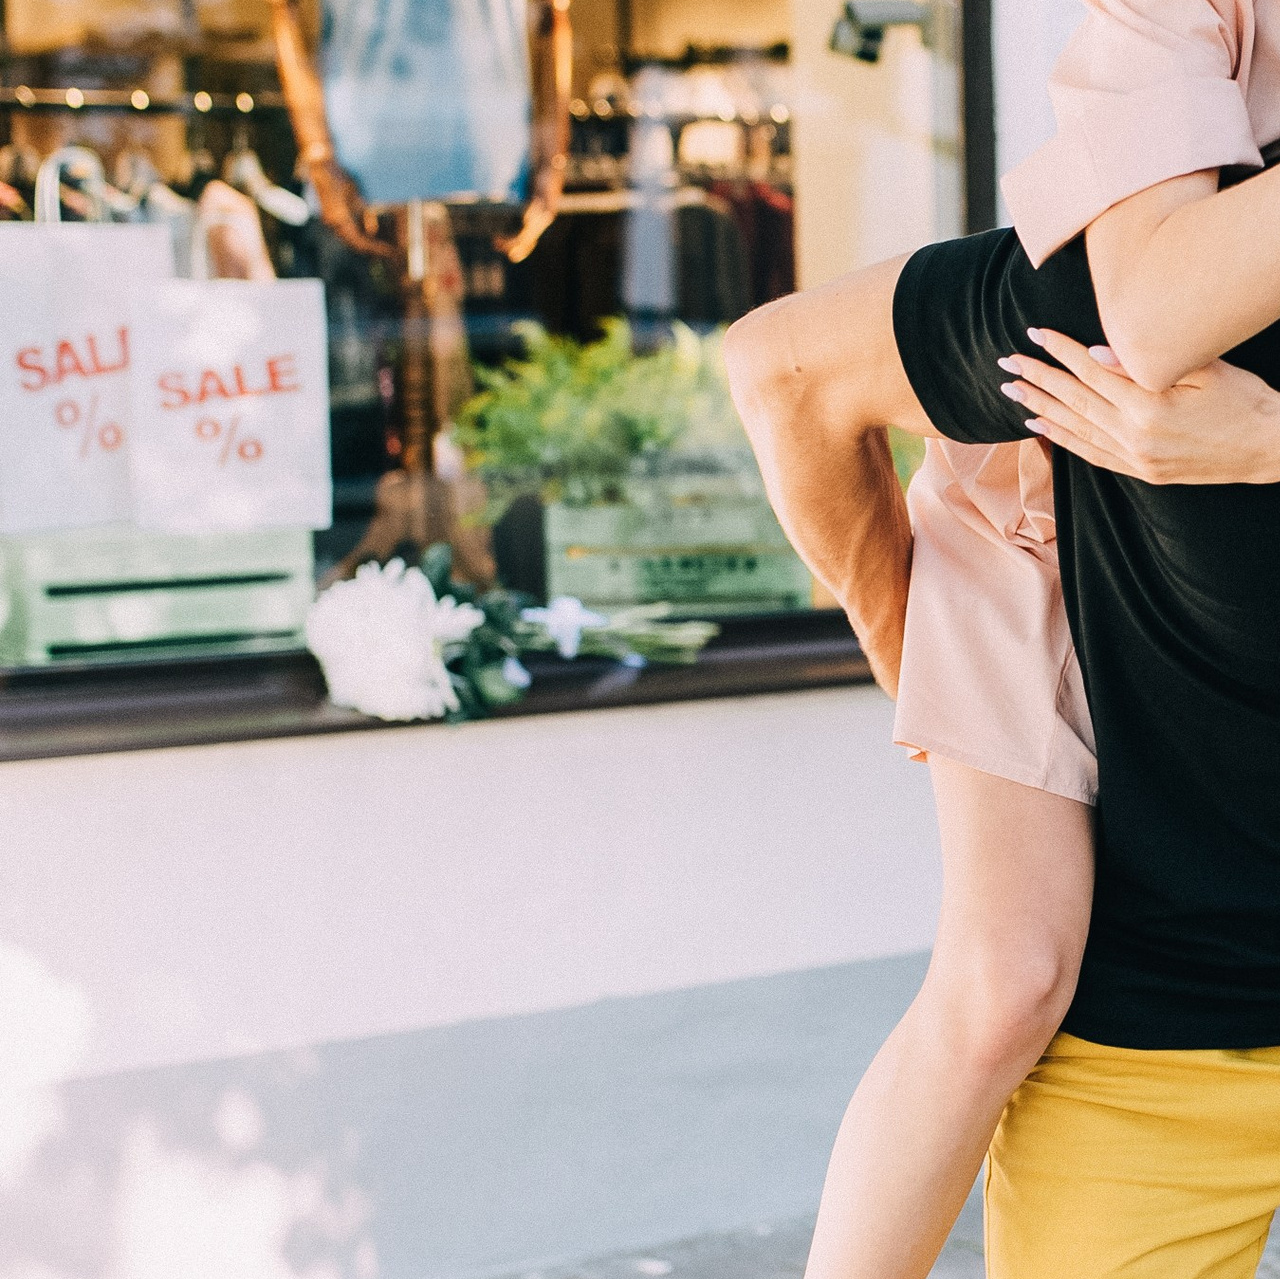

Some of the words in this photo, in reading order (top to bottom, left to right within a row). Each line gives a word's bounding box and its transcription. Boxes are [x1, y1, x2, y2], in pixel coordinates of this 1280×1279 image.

[157, 351, 303, 412] SALE
[53, 392, 128, 460] %
[193, 414, 265, 469] %
